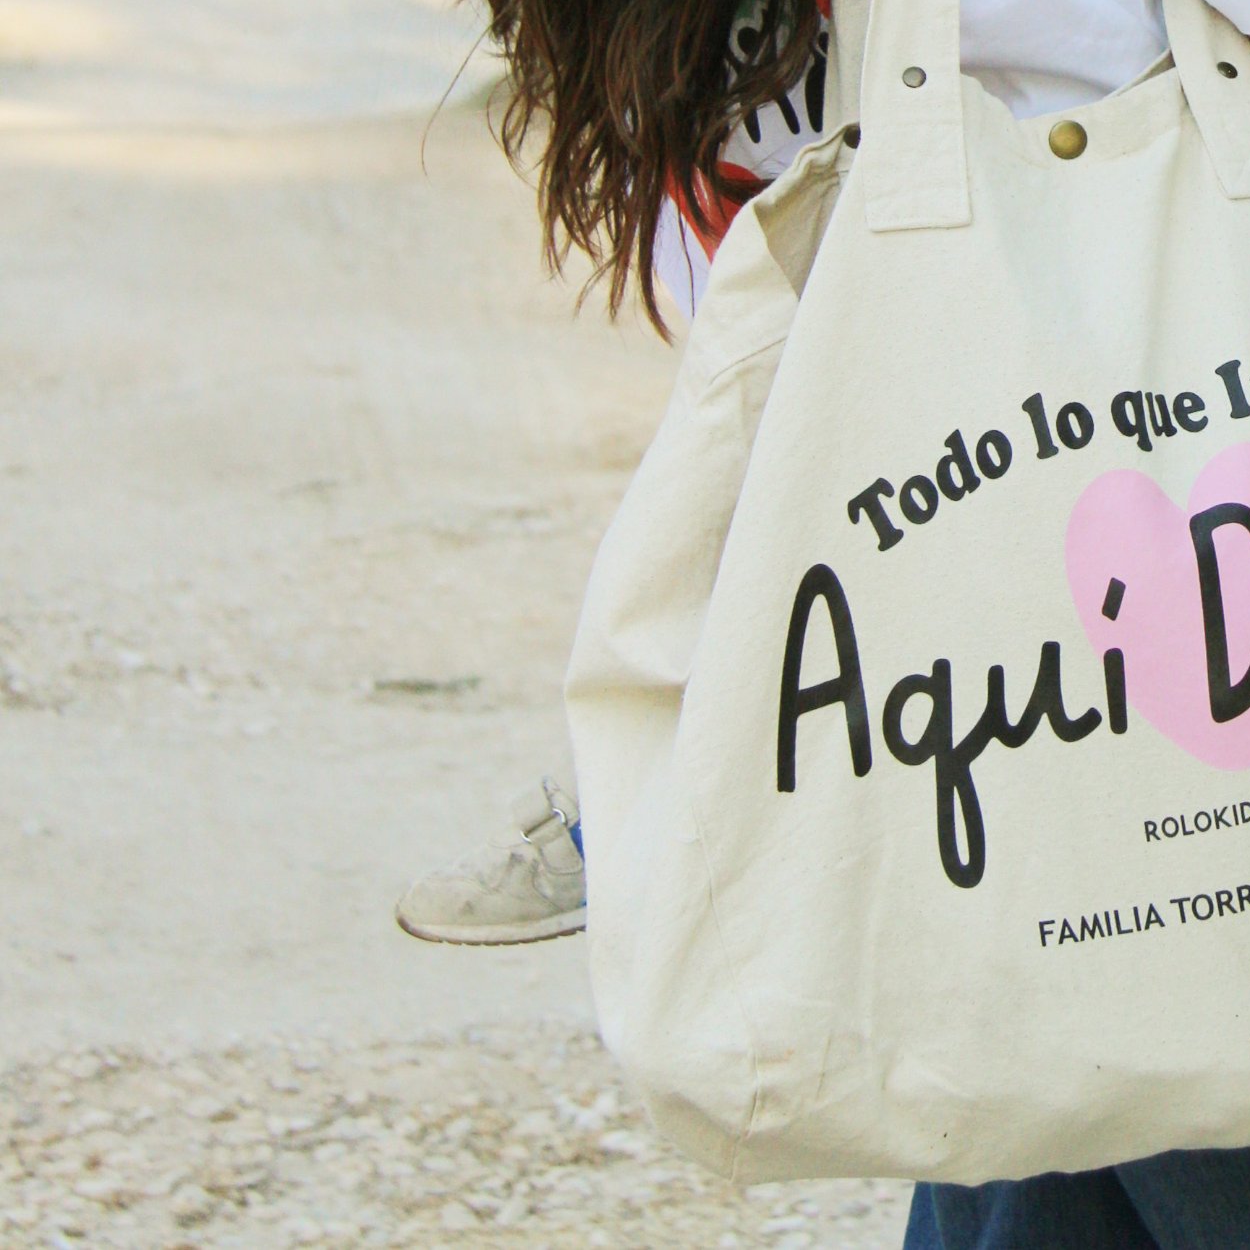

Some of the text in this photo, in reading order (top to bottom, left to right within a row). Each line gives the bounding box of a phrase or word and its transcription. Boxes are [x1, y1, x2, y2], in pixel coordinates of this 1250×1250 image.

[847, 429, 1013, 552] Todo
[1021, 392, 1095, 460] lo
[1110, 391, 1209, 453] que
[776, 563, 1128, 889] Aquí
[1038, 903, 1166, 947] FAMILIA
